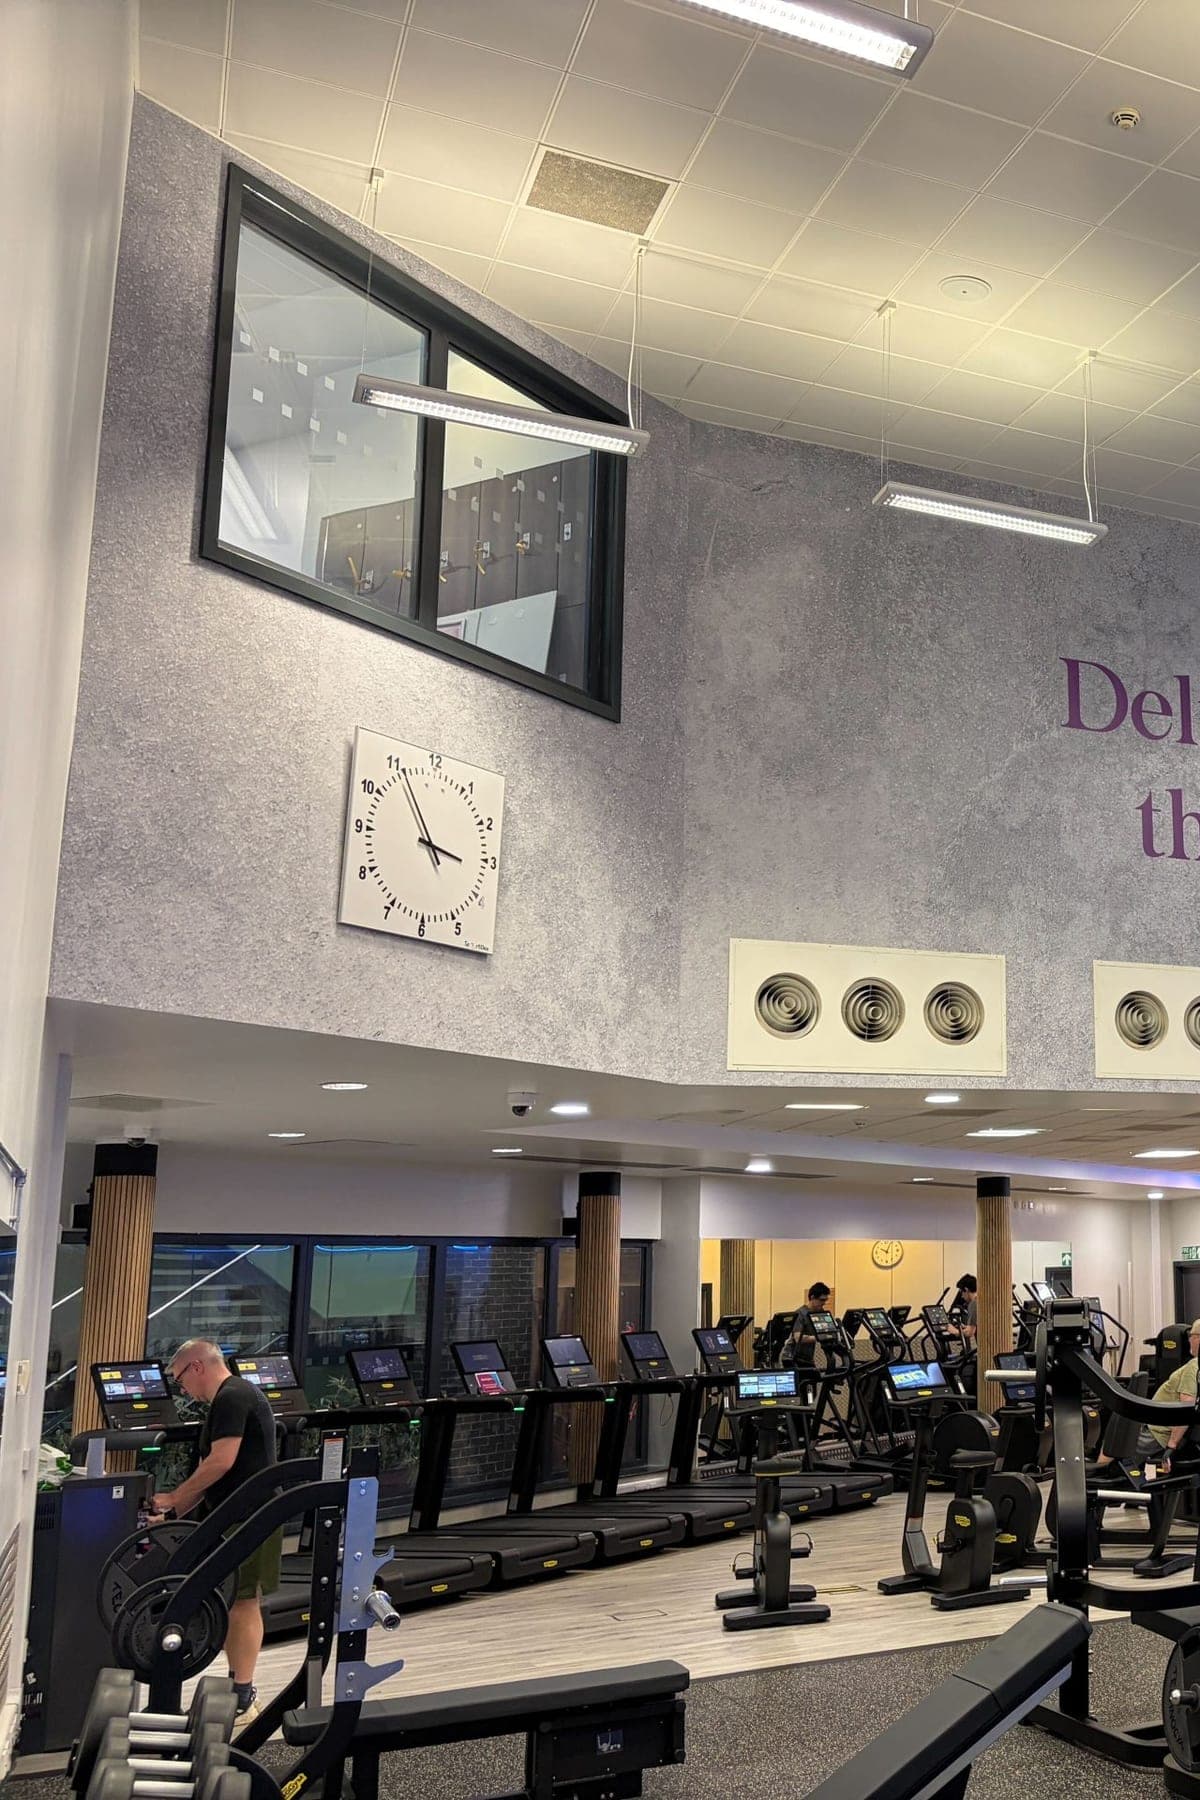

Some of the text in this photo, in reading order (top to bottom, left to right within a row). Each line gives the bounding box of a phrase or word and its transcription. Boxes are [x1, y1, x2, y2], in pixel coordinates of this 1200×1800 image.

[386, 755, 400, 771] 11
[428, 753, 442, 769] 12
[361, 778, 375, 795] 10
[468, 781, 474, 795] 1
[355, 818, 363, 833] 9
[486, 817, 493, 831] 2
[490, 856, 497, 870] 3
[359, 865, 367, 880] 8
[383, 906, 391, 920] 7
[418, 923, 425, 937] 6
[454, 922, 461, 936] 5
